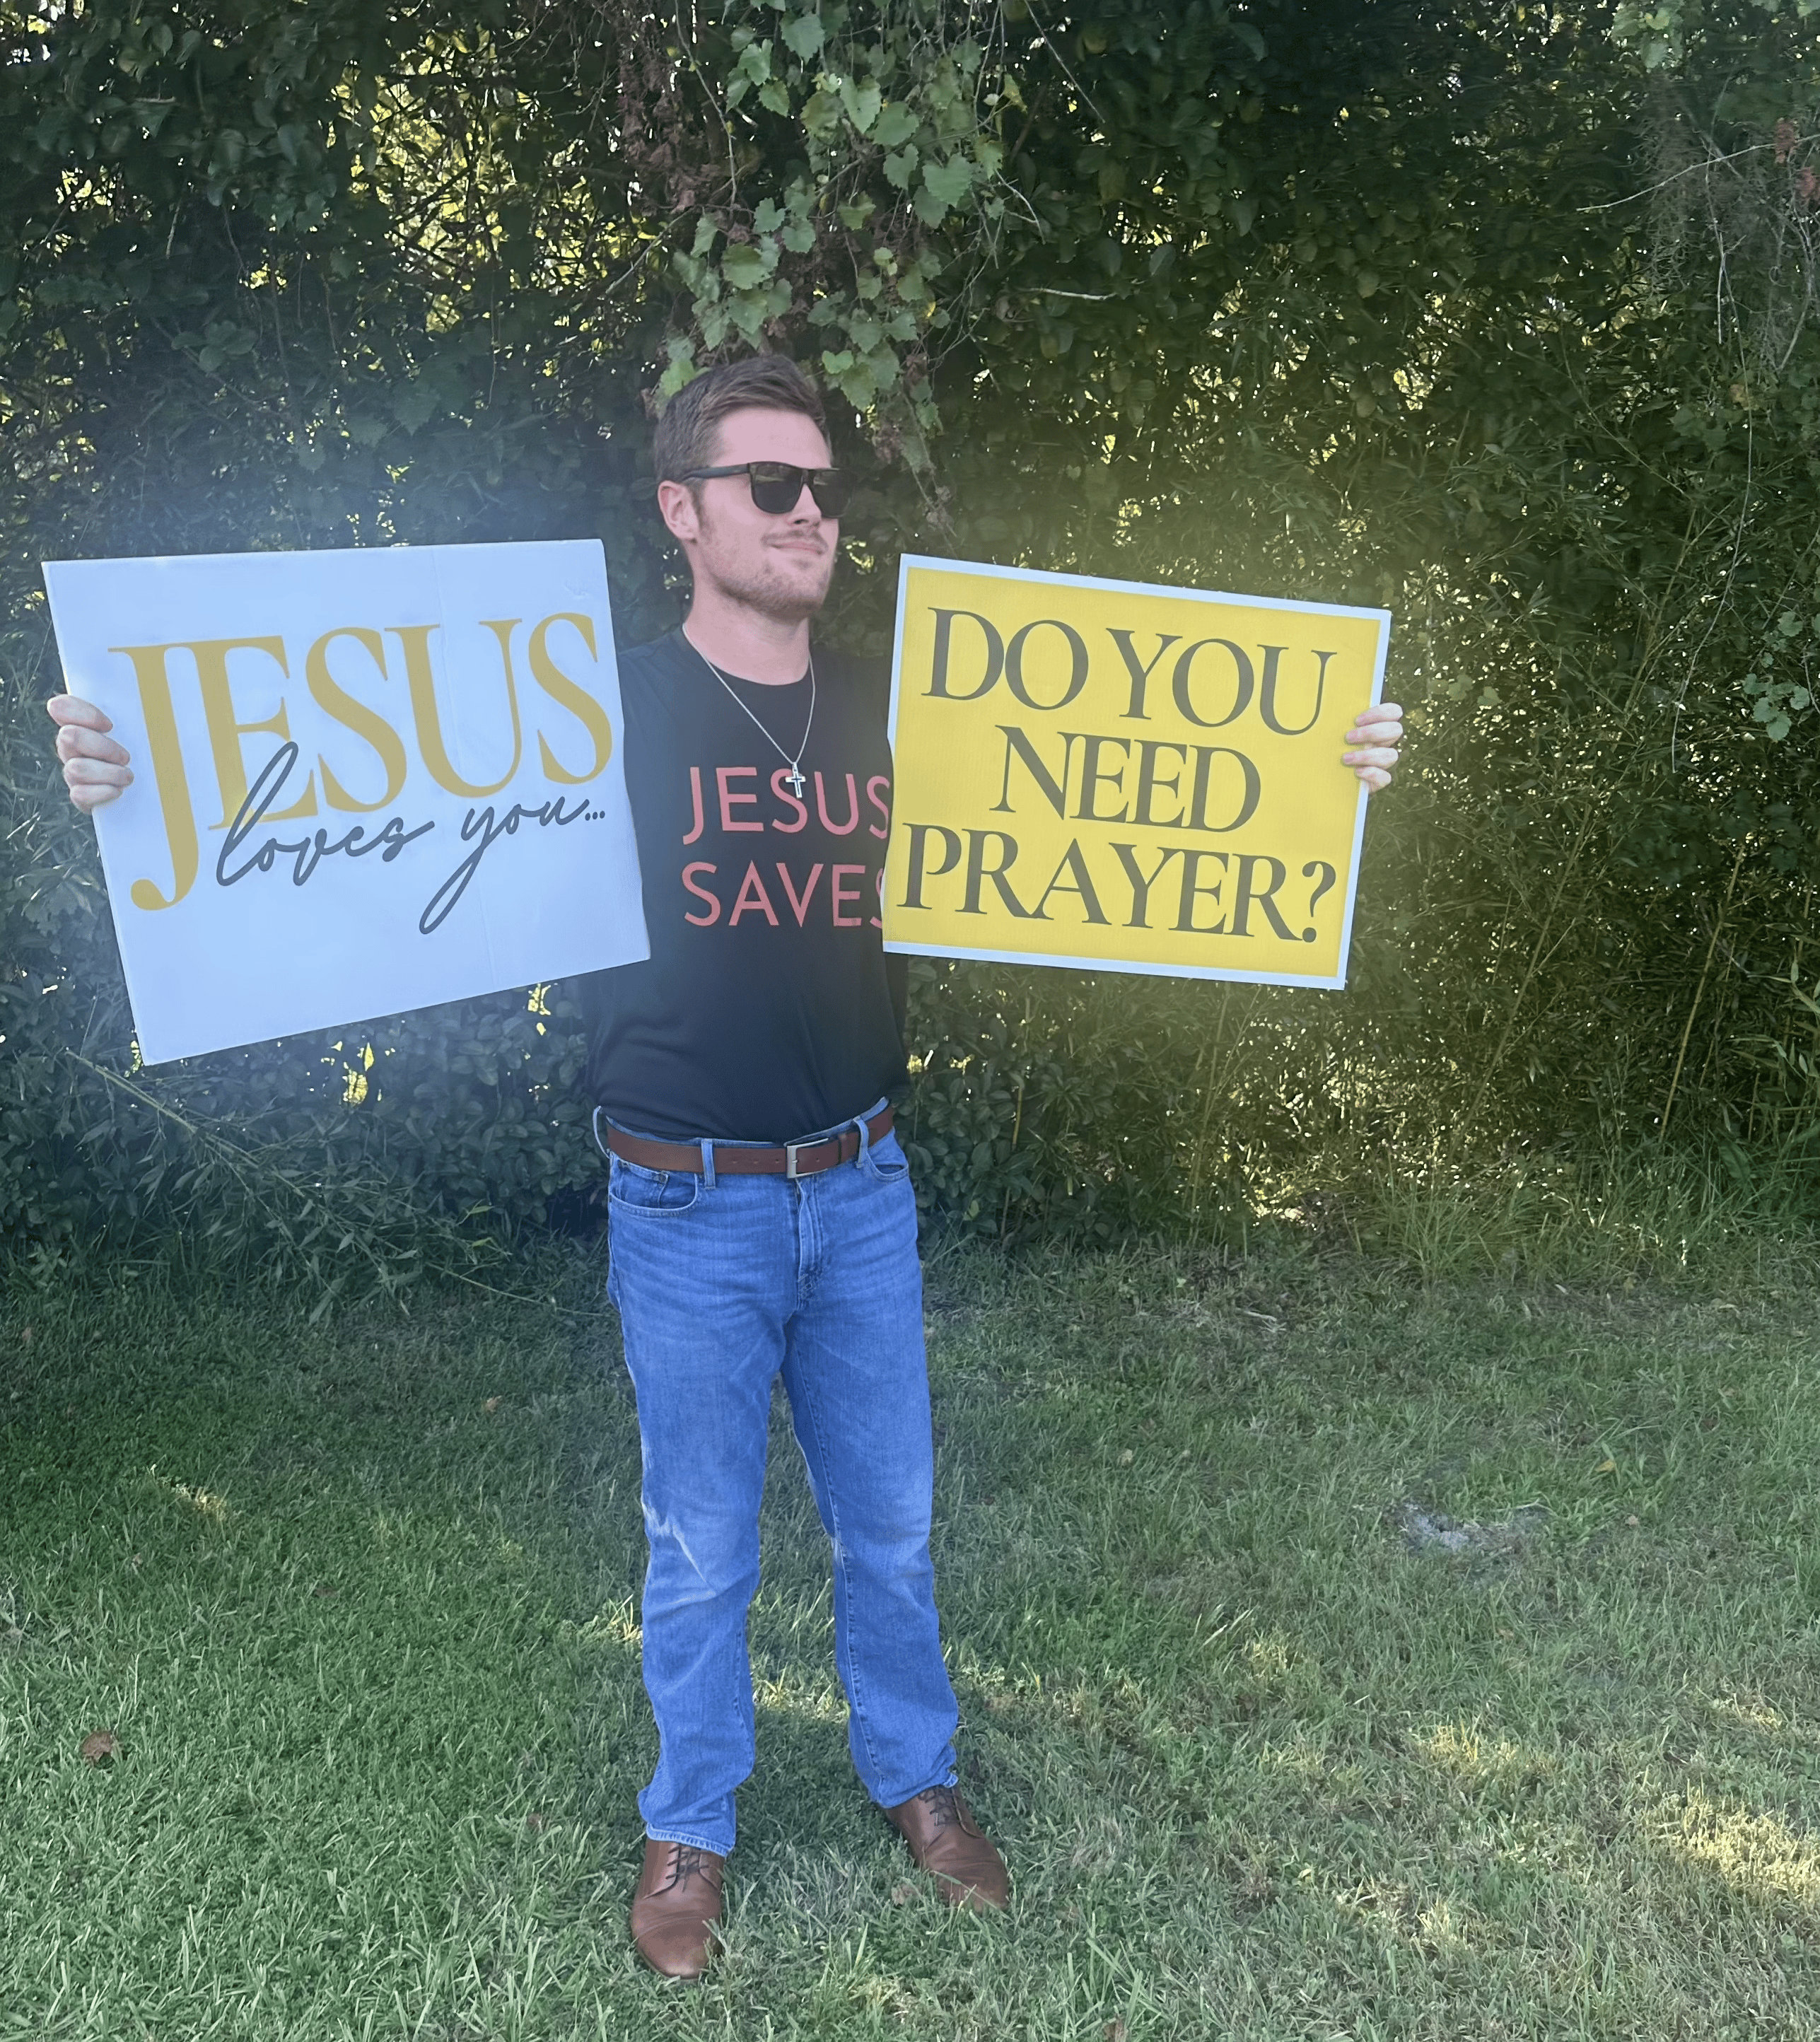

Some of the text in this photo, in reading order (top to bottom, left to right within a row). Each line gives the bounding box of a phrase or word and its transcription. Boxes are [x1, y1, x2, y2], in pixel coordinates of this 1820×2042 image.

[921, 606, 1338, 736] DO YOU
[107, 612, 613, 911] JESUS
[216, 740, 436, 887] loves
[682, 766, 890, 845] JESUS
[988, 724, 1261, 833] NEED
[896, 822, 1337, 943] PRAYER?
